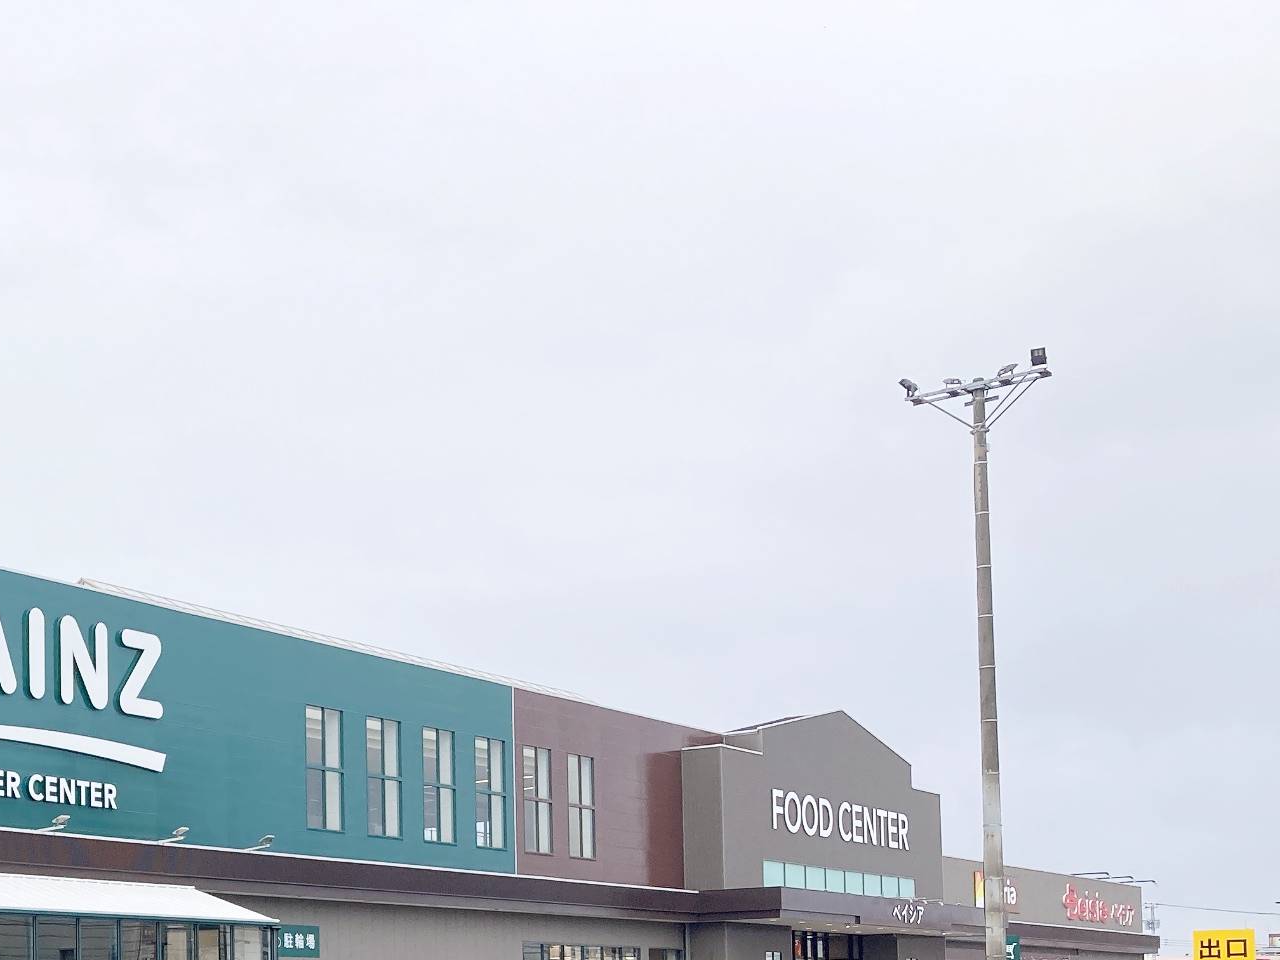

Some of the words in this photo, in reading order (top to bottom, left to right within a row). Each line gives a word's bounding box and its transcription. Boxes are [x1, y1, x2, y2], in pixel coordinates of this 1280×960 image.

[27, 773, 118, 810] CENTER
[771, 788, 834, 838] FOOD
[839, 801, 910, 851] CENTER
[283, 932, 316, 950] 駐輪場
[1199, 938, 1248, 959] 出口
